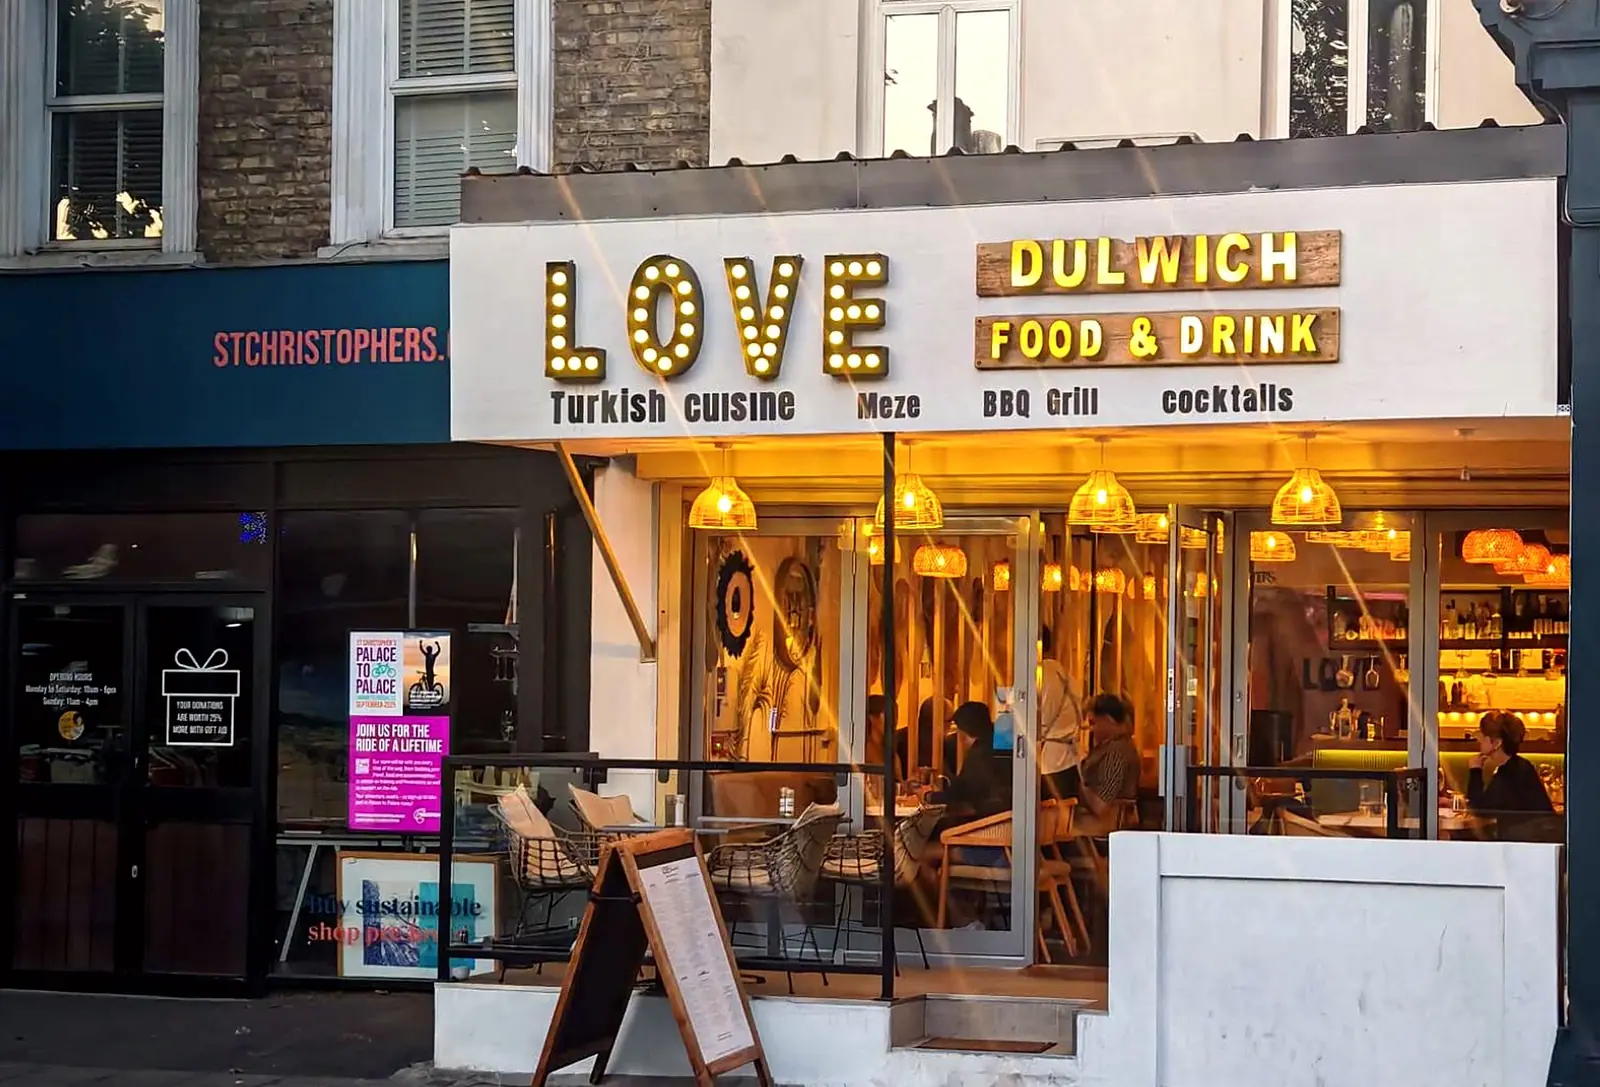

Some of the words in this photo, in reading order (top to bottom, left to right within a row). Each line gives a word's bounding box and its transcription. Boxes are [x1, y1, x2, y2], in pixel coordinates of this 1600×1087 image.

[1011, 231, 1298, 288] DULWICH
[544, 253, 889, 383] LOVE
[213, 326, 450, 367] STCHRISTOPHERS.
[990, 319, 1103, 359] FOOD
[1128, 316, 1158, 357] &
[1180, 313, 1318, 355] DRINK
[551, 388, 666, 424] Turkish
[857, 392, 920, 419] Meze
[983, 389, 1030, 419] BBQ
[1046, 386, 1098, 416] Grill
[356, 647, 396, 662] PALACE
[357, 663, 370, 678] TO
[356, 679, 396, 694] PALACE
[356, 723, 376, 738] JOIN
[378, 724, 390, 738] US
[392, 724, 410, 738] FOR
[412, 724, 430, 738] THE
[356, 738, 377, 752] RIDE
[379, 738, 391, 752] OF
[392, 739, 399, 752] A
[401, 739, 443, 753] LIFETIME
[308, 921, 360, 948] shop
